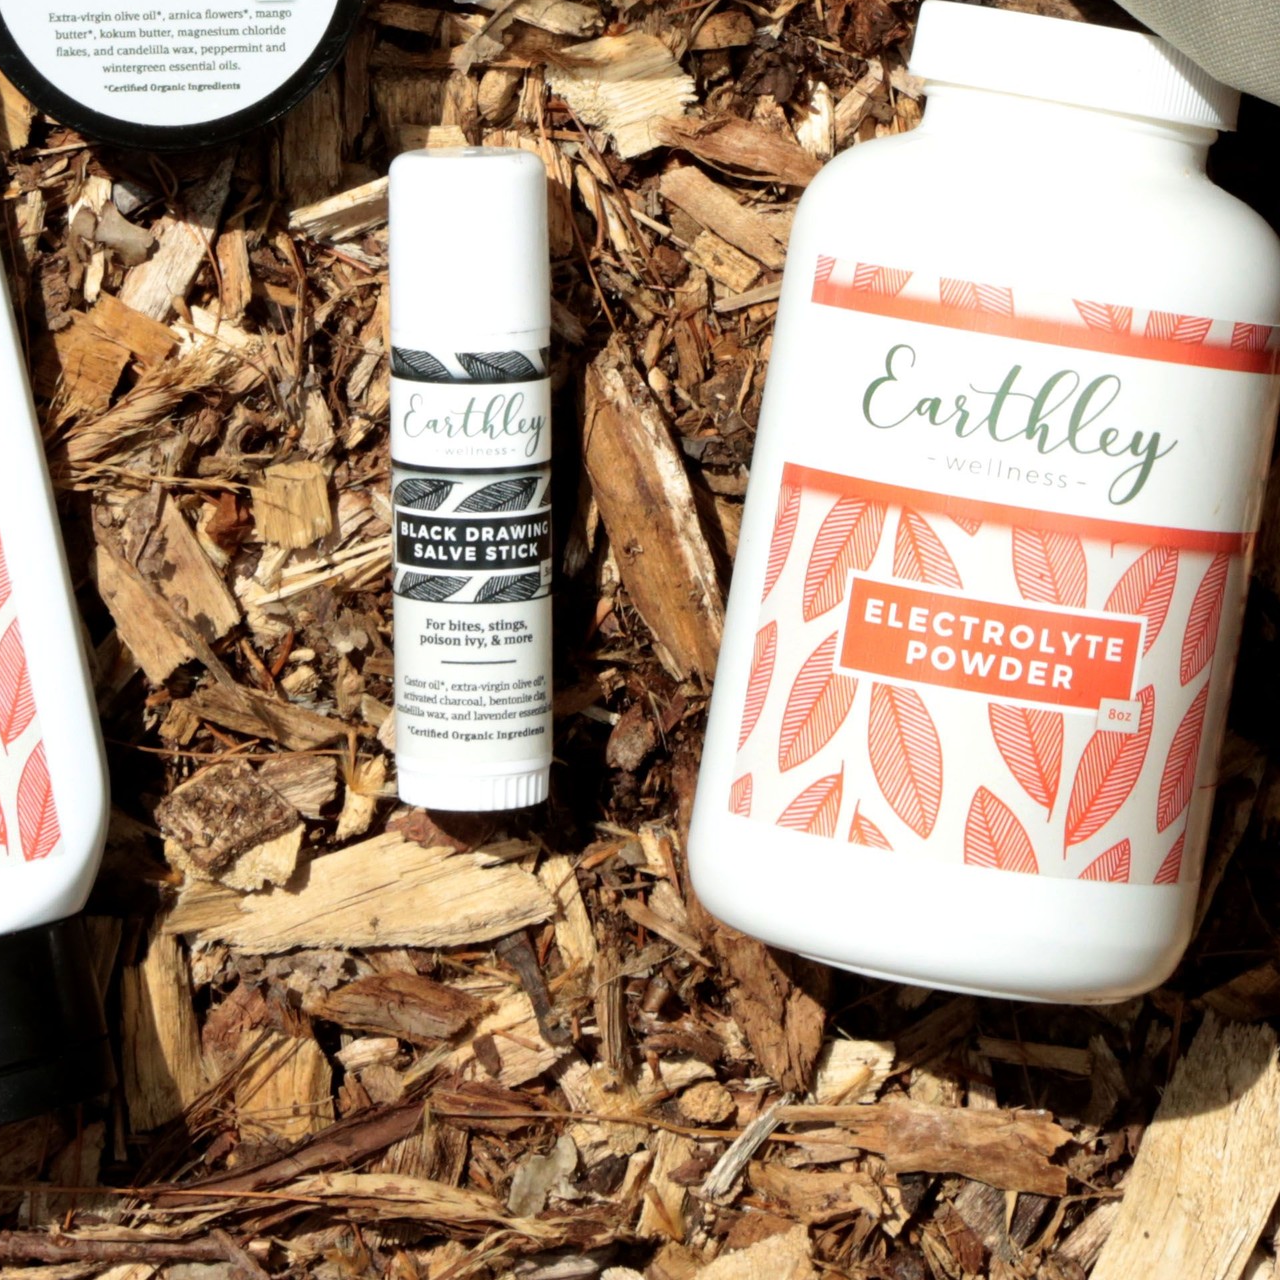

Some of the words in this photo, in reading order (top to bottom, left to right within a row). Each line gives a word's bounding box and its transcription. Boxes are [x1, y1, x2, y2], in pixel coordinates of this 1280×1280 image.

[48, 12, 112, 24] Extra-virgin
[114, 11, 140, 21] olive
[169, 10, 202, 21] arnica
[255, 9, 292, 20] mango
[100, 29, 136, 39] kokum
[139, 28, 174, 38] butter,
[177, 27, 240, 38] magnesium
[242, 25, 286, 35] chloride
[56, 47, 90, 57] flakes,
[93, 46, 114, 56] and
[117, 45, 170, 55] candelilla
[172, 46, 198, 55] wax,
[201, 44, 262, 55] peppermint
[265, 42, 286, 52] and
[103, 63, 166, 74] wintergreen
[169, 61, 216, 71] essential
[219, 60, 241, 70] oils.
[150, 83, 185, 93] Organic
[188, 82, 240, 91] Ingredients
[404, 392, 546, 457] Earthley
[862, 344, 1178, 505] Earthley
[401, 522, 456, 541] BLACK
[466, 521, 548, 541] DRAWING
[414, 544, 476, 561] SALVE
[486, 543, 538, 560] STICK
[426, 619, 446, 630] For
[449, 620, 485, 632] bites,
[489, 619, 528, 632] stings,
[864, 598, 1124, 663] ELECTROLYTE
[420, 634, 461, 646] poison
[465, 635, 487, 648] ivy,
[491, 636, 501, 645] &
[504, 633, 533, 644] more
[905, 640, 1074, 690] POWDER
[404, 675, 426, 688] Castor
[451, 682, 510, 692] extra-virgin
[512, 680, 532, 691] olive
[404, 692, 437, 704] activated
[439, 696, 486, 707] charcoal,
[489, 695, 532, 705] bentonite
[427, 711, 449, 720] wax,
[451, 711, 471, 720] and
[474, 710, 517, 720] lavender
[1107, 707, 1132, 721] 8oz
[452, 731, 494, 742] Organic
[497, 726, 545, 740] Ingredients
